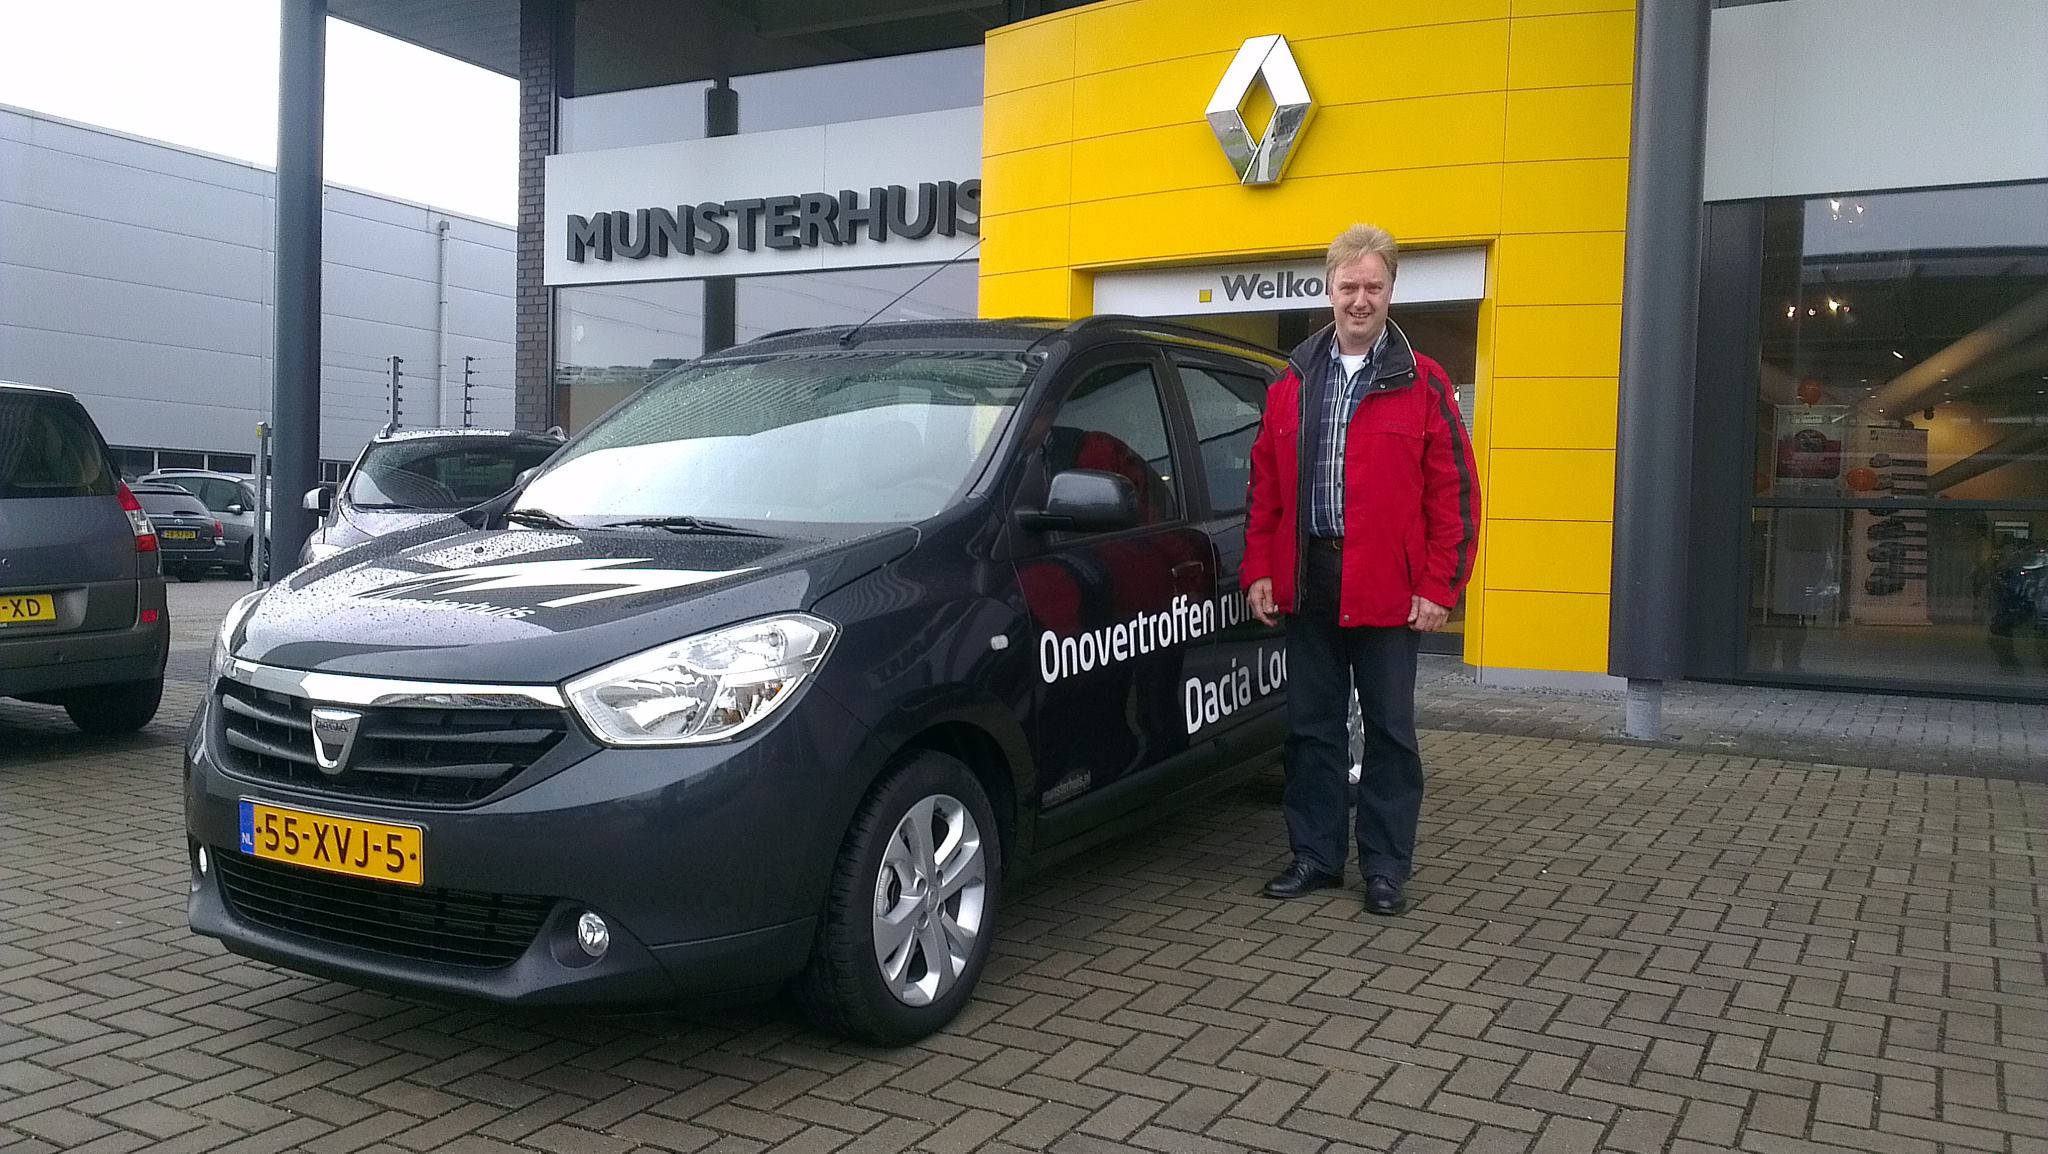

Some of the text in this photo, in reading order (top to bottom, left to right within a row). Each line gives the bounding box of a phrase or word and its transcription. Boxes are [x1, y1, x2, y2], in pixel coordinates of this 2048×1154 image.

[567, 179, 981, 263] MUNSTERHUIS
[1220, 271, 1328, 302] Welko
[1039, 593, 1215, 685] Onovertroffen
[1185, 657, 1252, 735] Dacia
[241, 831, 254, 846] NL
[264, 813, 405, 874] 55-XVJ-5
